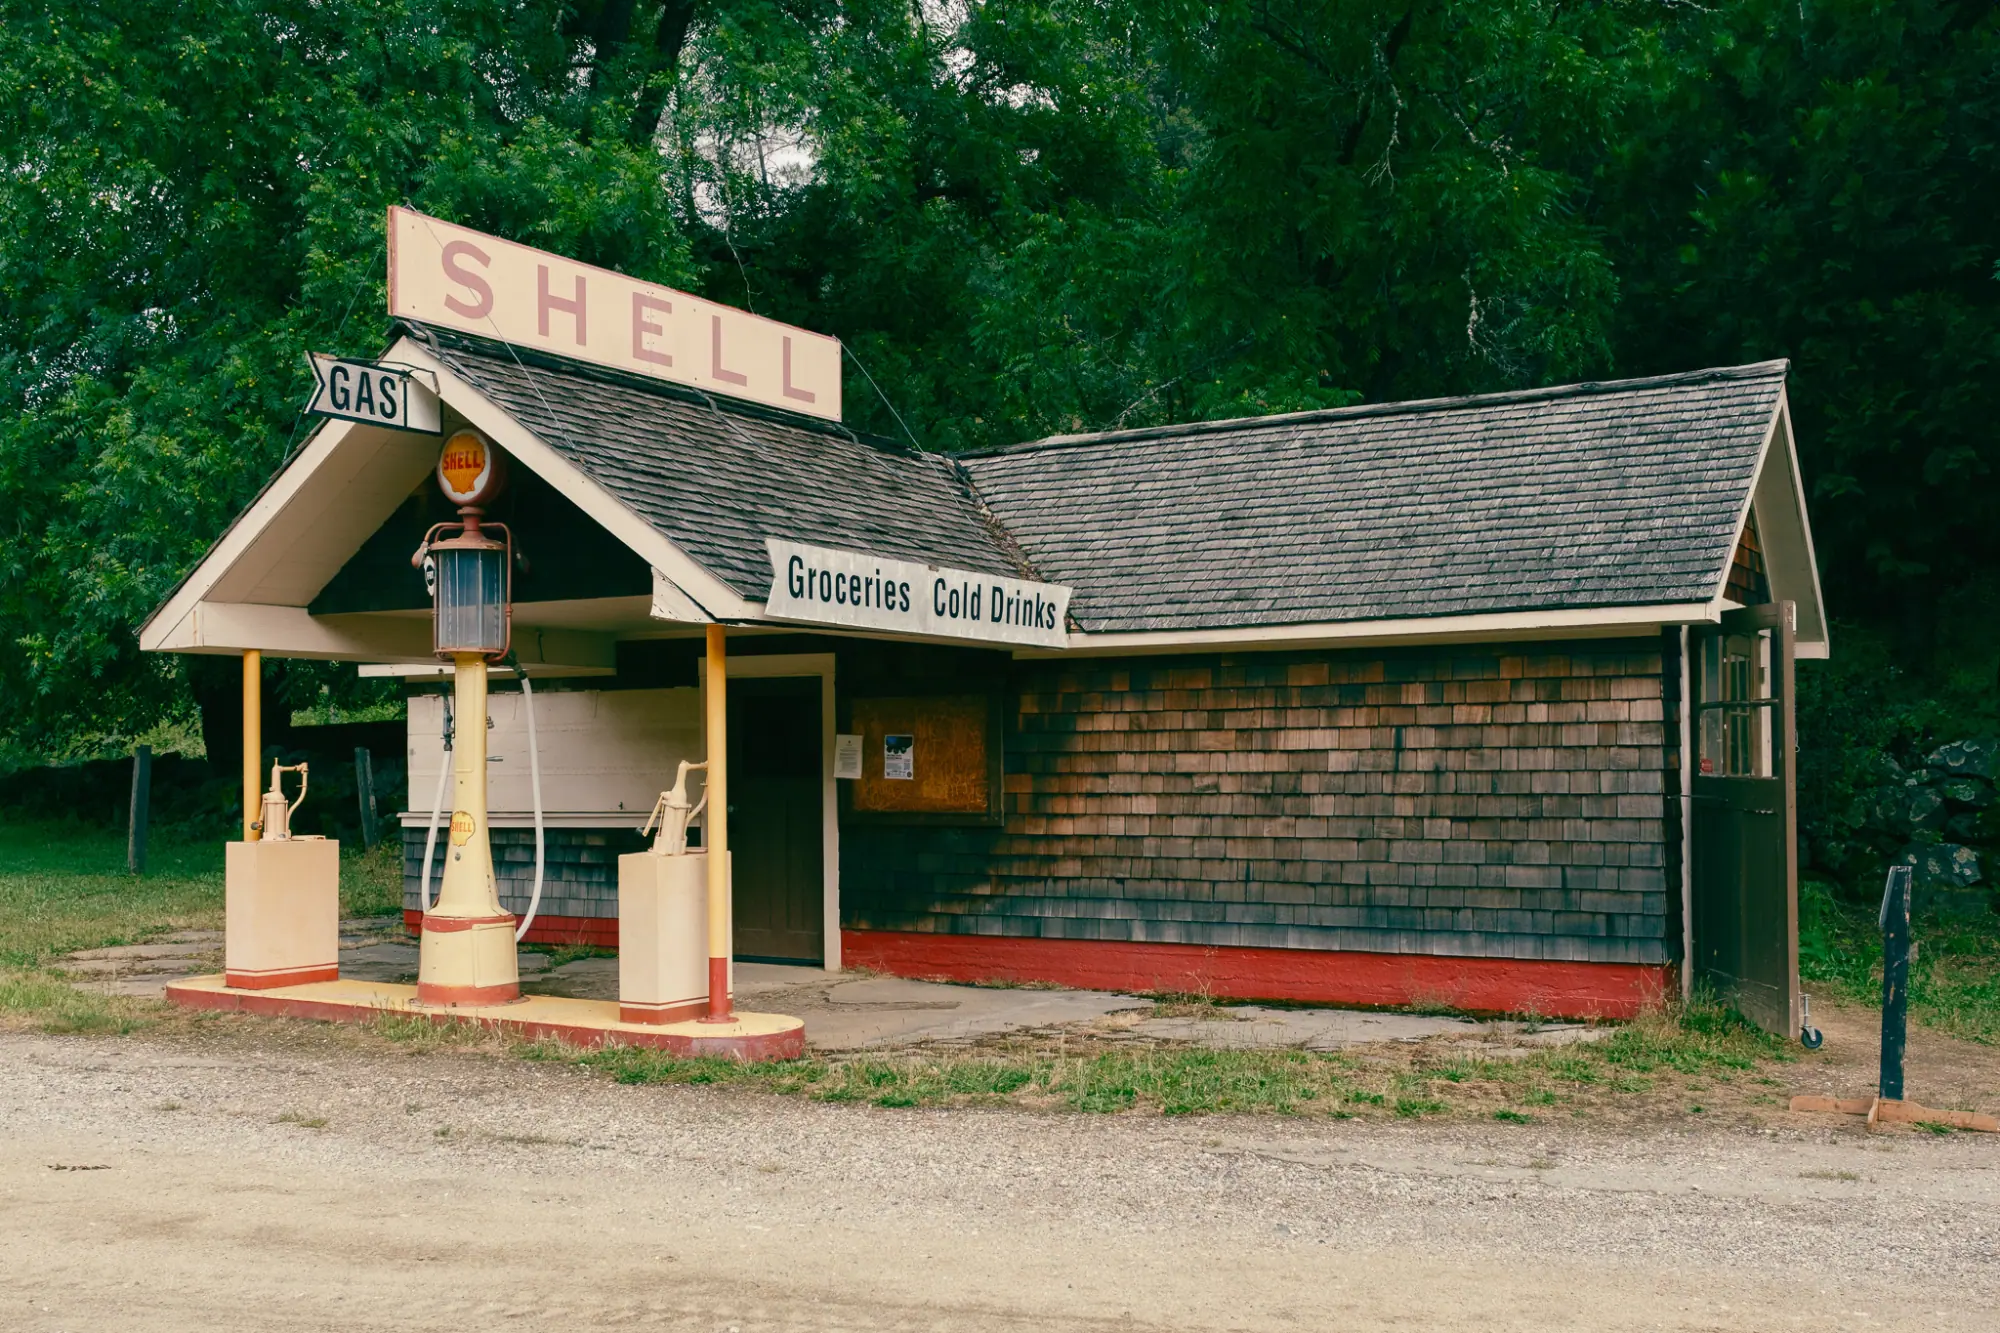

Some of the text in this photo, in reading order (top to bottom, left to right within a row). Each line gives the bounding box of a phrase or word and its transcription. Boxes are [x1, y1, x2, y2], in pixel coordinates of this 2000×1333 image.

[441, 240, 816, 404] SHELL
[330, 365, 397, 419] GAS
[443, 450, 481, 471] SHELL
[788, 554, 1056, 630] Groceries Cold Drinks
[451, 821, 472, 832] SHELL
